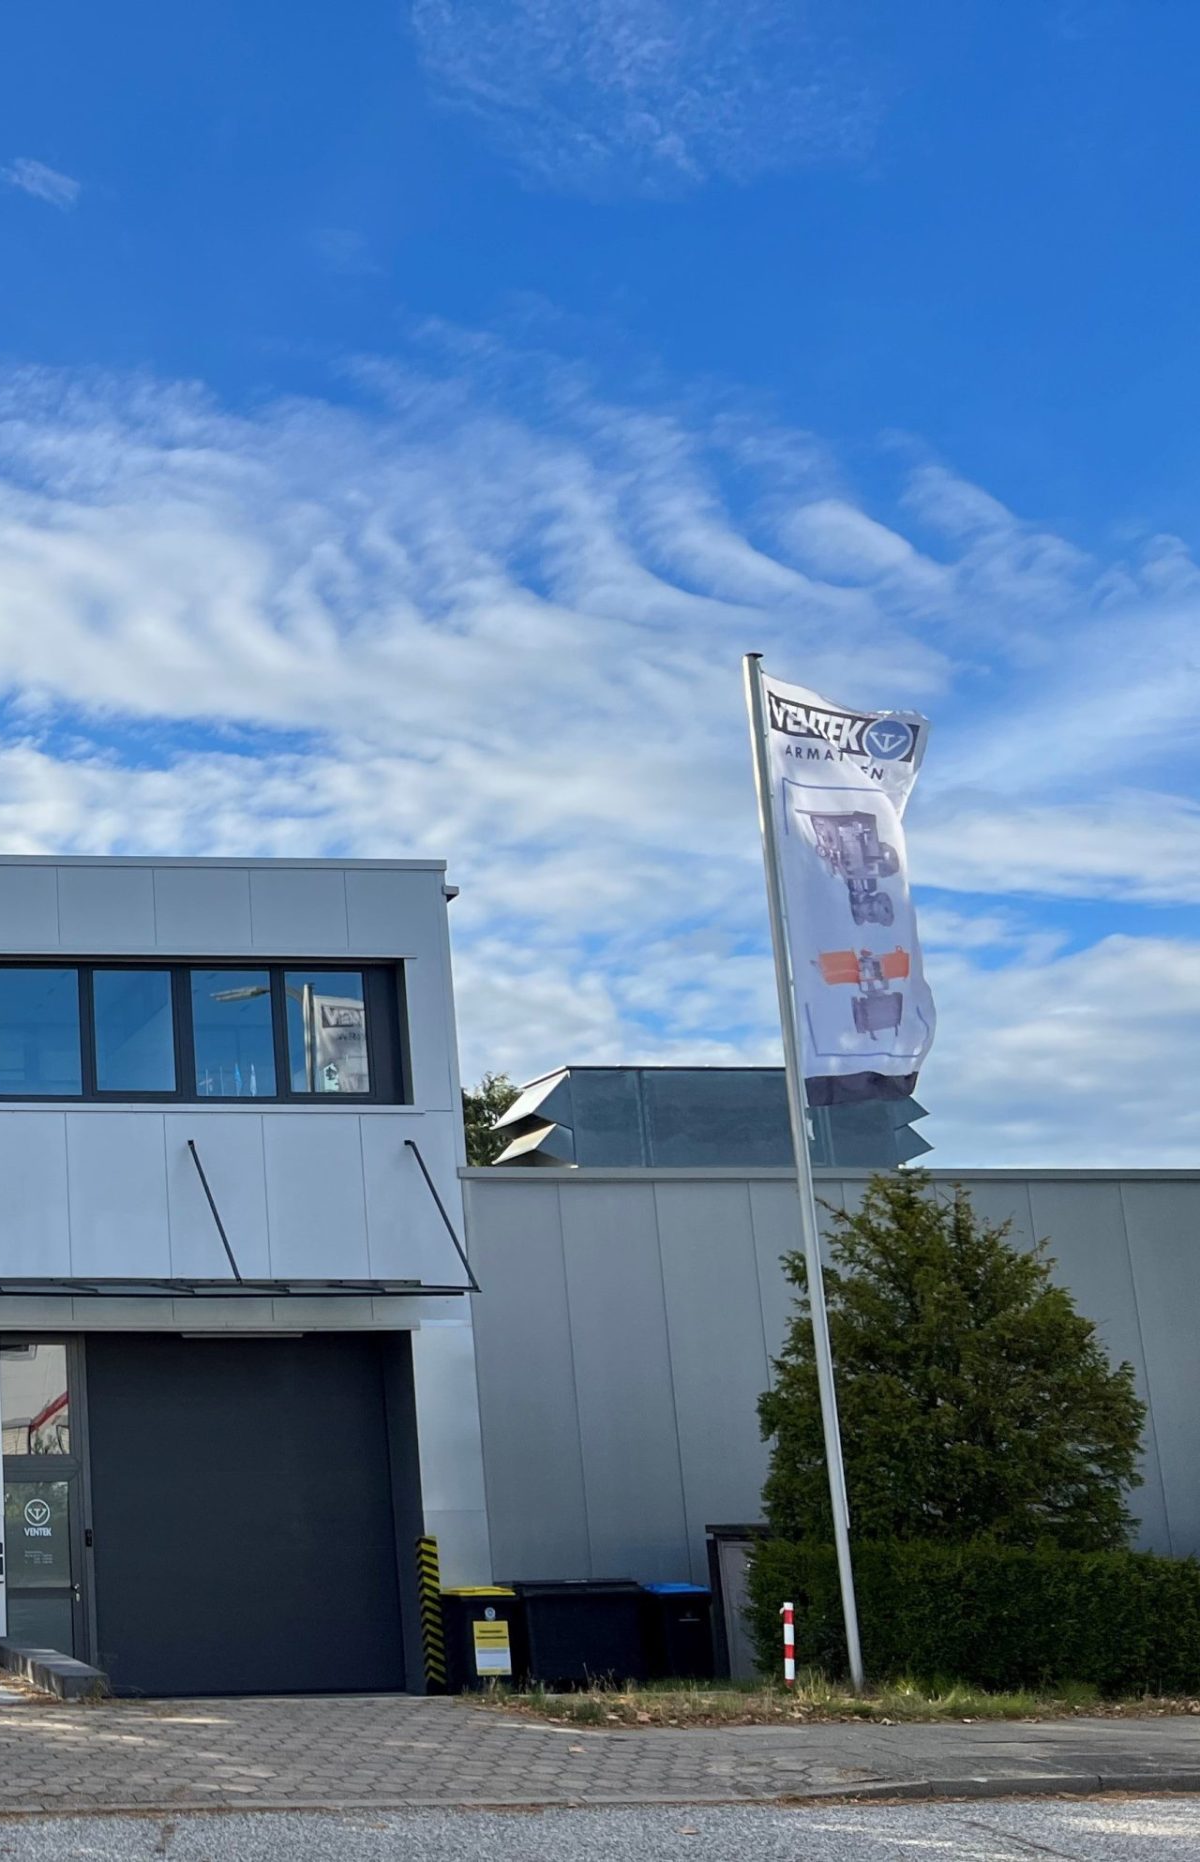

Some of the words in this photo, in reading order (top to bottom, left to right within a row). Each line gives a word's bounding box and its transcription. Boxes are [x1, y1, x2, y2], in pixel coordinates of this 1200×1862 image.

[770, 696, 866, 751] VENTEK
[785, 744, 884, 780] ARMATEN
[24, 1527, 52, 1537] VENTEK
